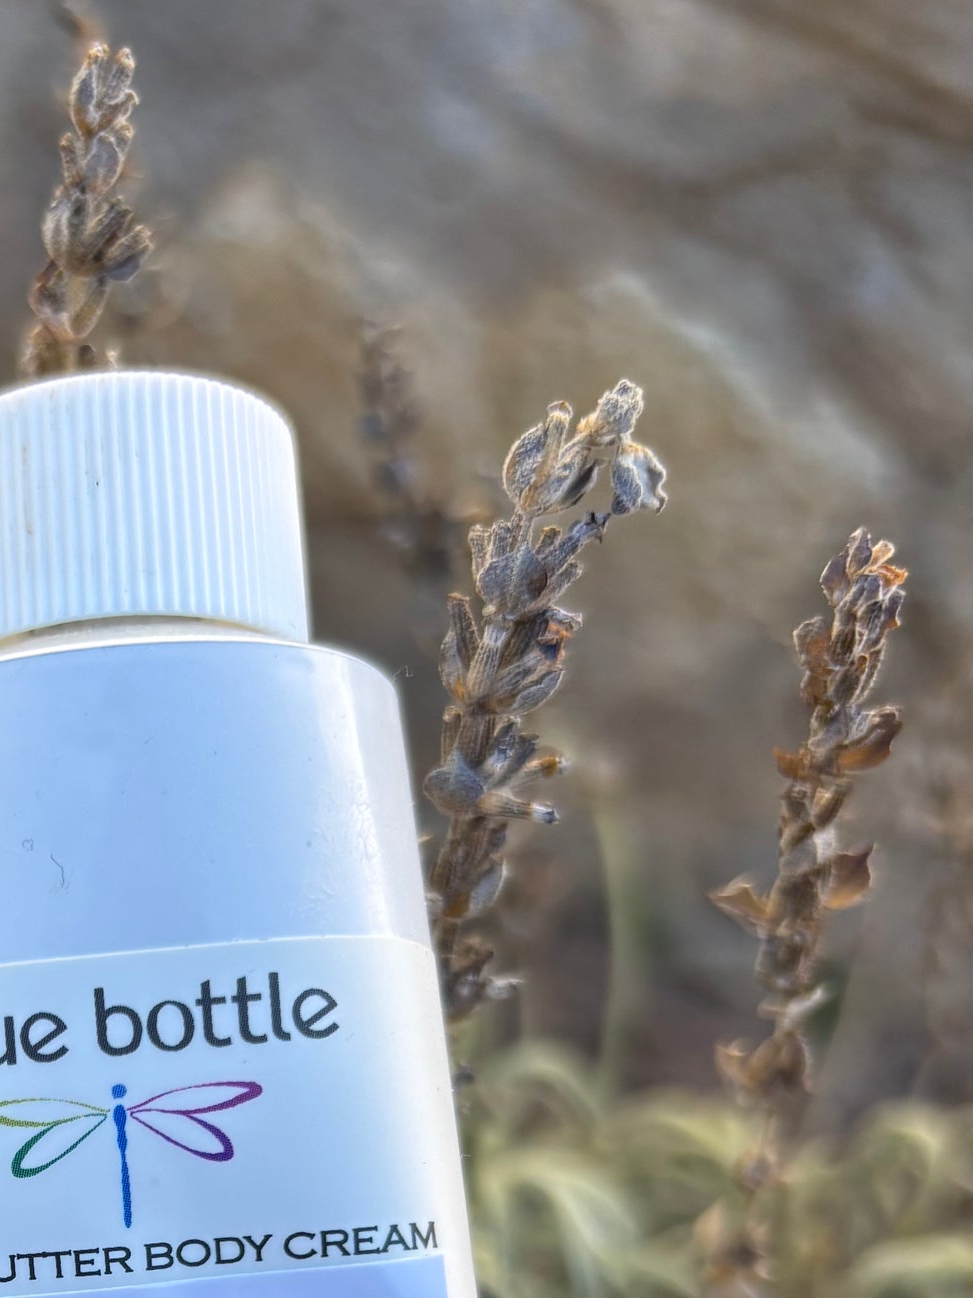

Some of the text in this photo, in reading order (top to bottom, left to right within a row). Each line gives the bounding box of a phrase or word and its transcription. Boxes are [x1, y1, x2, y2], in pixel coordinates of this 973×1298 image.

[93, 972, 340, 1057] bottle
[145, 1234, 274, 1273] BODY
[283, 1221, 439, 1259] CREAM
